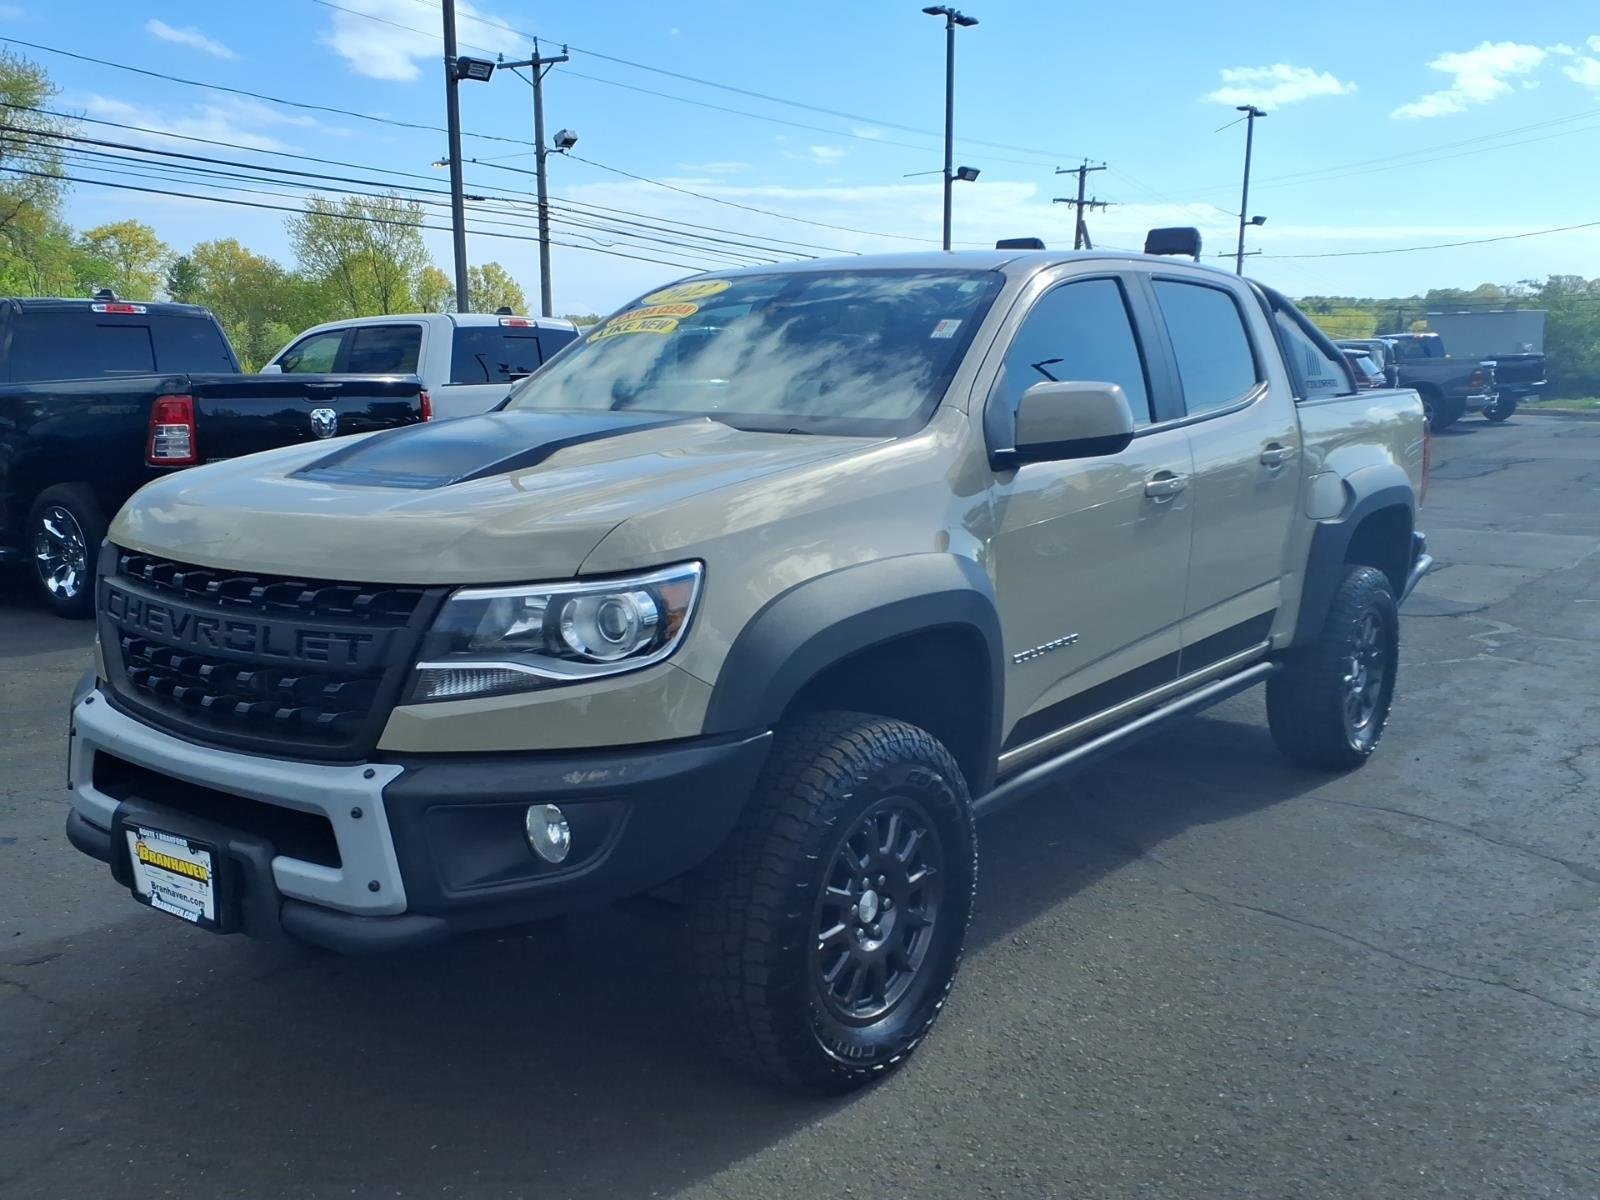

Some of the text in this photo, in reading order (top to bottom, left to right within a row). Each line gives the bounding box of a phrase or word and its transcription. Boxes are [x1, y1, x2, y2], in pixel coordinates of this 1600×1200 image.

[599, 319, 672, 337] LIKE NEW
[107, 589, 374, 665] CHEVROLET
[139, 845, 209, 882] BRANHAVEN
[151, 881, 206, 908] Branhaven.com
